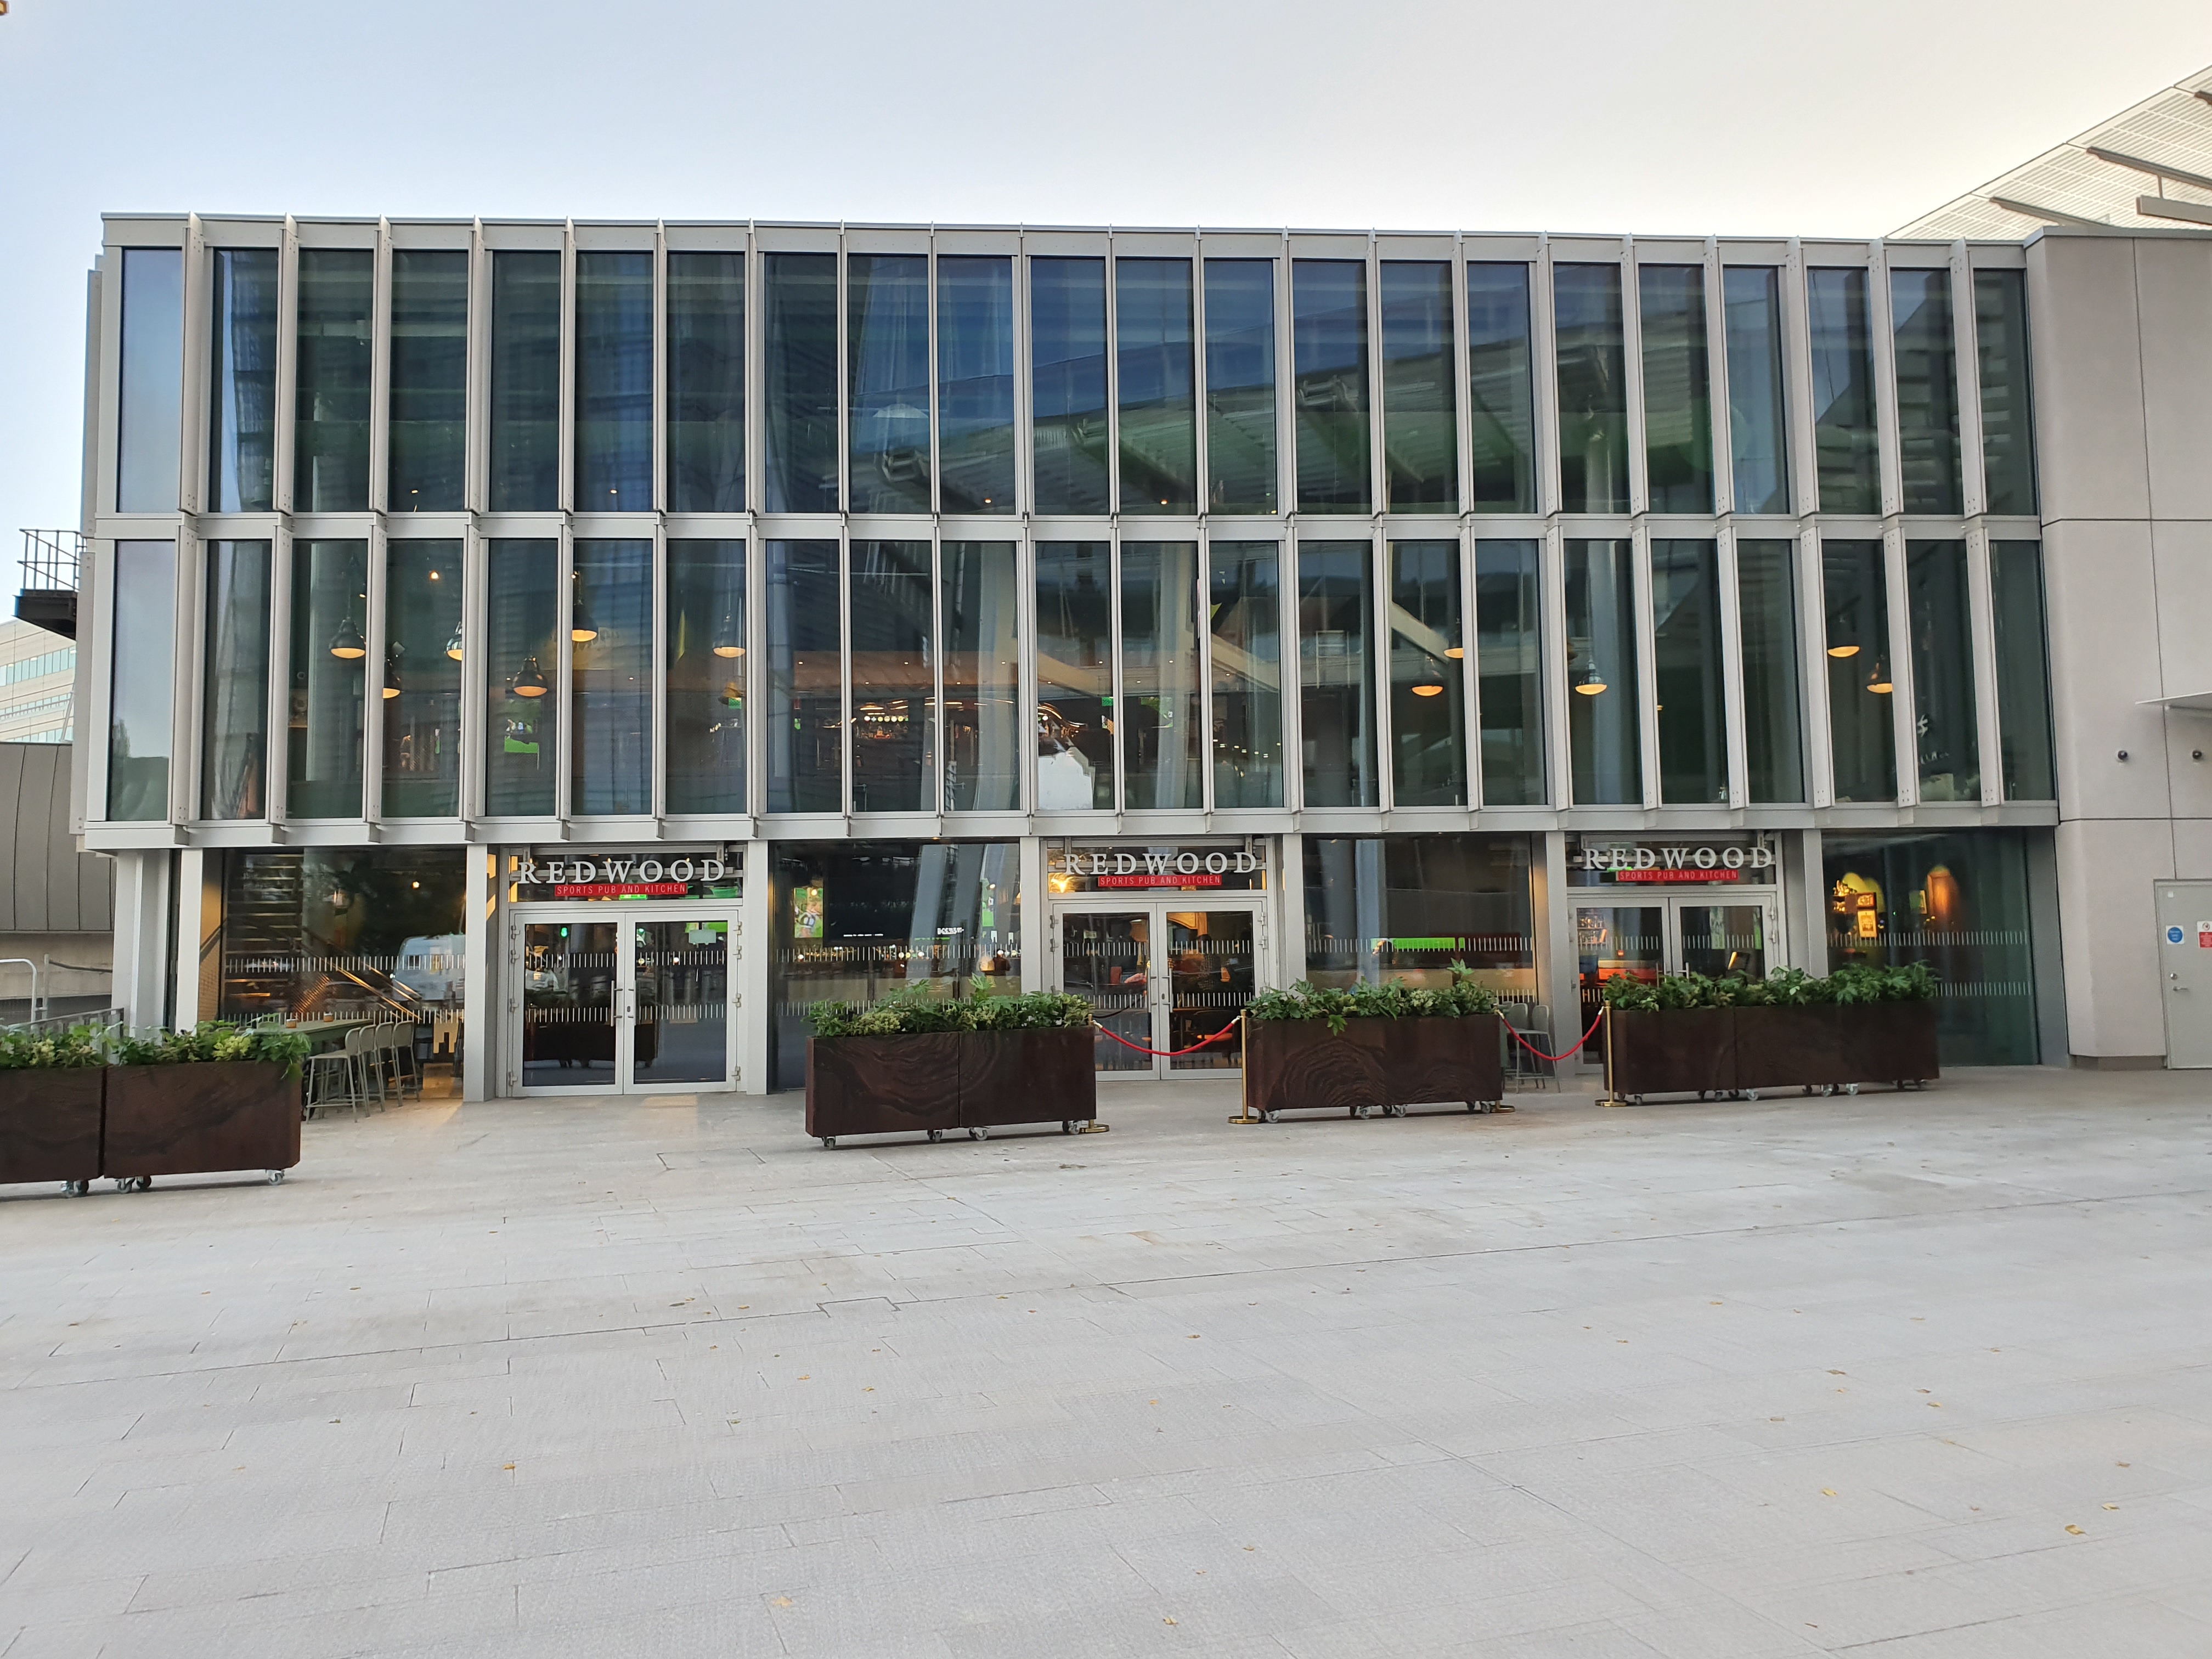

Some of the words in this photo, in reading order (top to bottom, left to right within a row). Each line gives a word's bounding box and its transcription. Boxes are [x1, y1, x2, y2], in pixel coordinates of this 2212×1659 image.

[1063, 852, 1257, 876] REDWOOD
[1583, 847, 1773, 870] REDWOOD
[517, 859, 725, 884] REDWOOD
[1100, 876, 1134, 885] SPORTS
[1138, 876, 1156, 884] PUB
[1160, 876, 1178, 884] AND
[1182, 875, 1221, 884] KITCHEN
[1620, 871, 1654, 880] SPORTS
[1657, 871, 1674, 879] PUB
[1678, 870, 1695, 879] AND
[1700, 870, 1737, 879] KITCHEN
[557, 885, 593, 895] SPORTS
[598, 884, 616, 894] PUB
[622, 884, 640, 893] AND
[645, 883, 686, 893] KITCHEN
